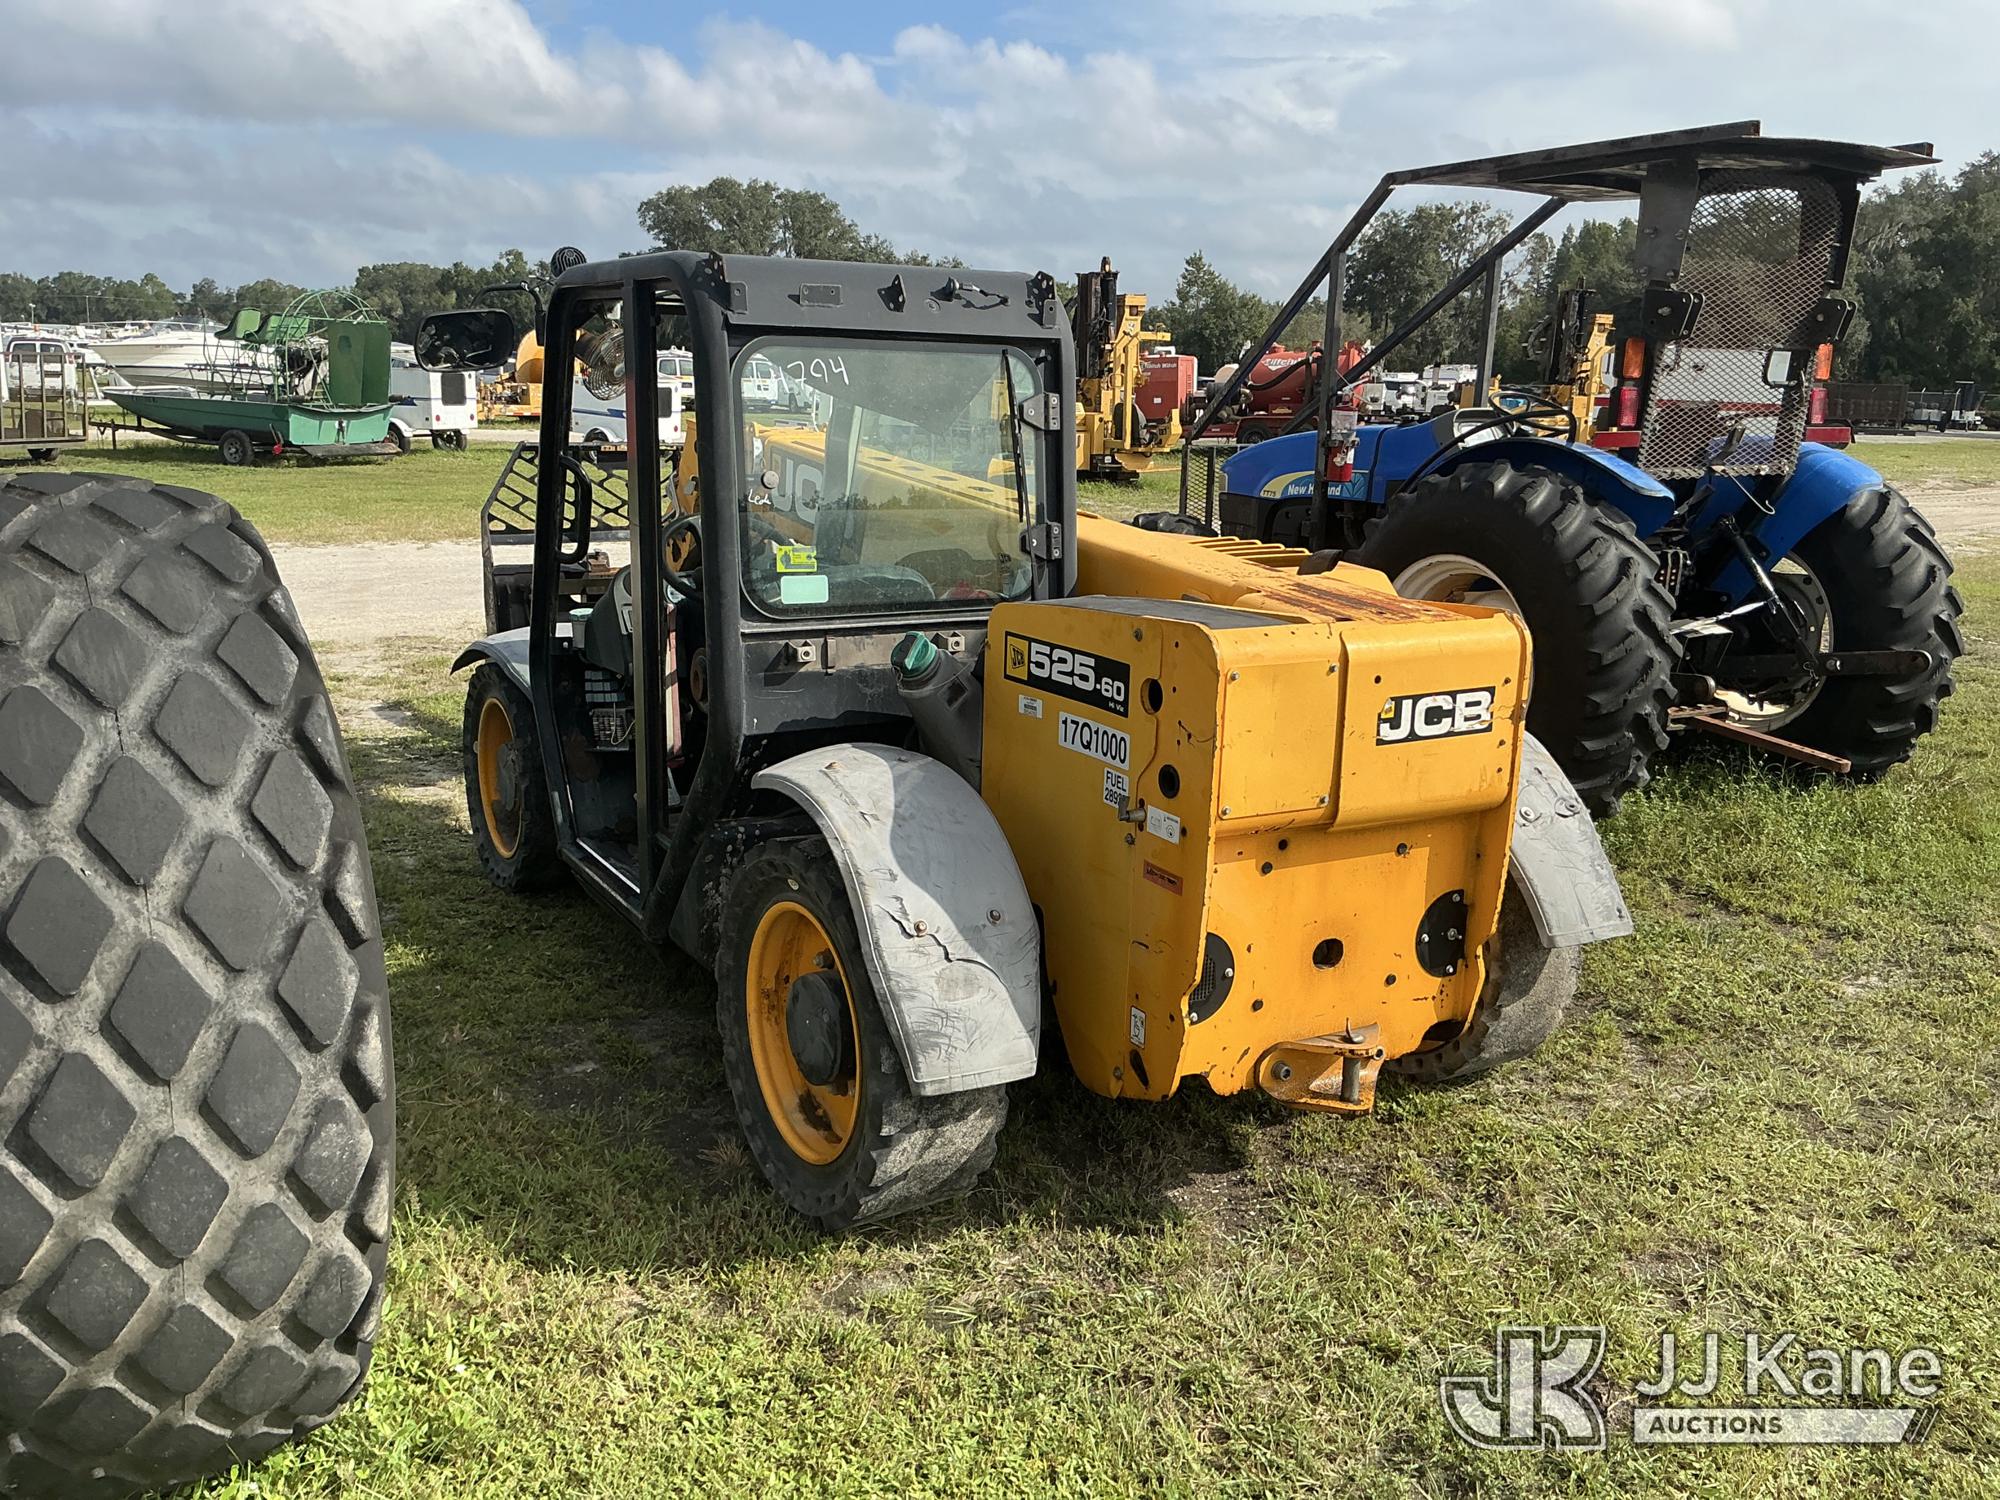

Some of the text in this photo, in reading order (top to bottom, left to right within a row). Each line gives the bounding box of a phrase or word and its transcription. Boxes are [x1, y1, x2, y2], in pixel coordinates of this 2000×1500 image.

[771, 458, 822, 524] JC
[1287, 484, 1307, 495] New
[1380, 691, 1492, 741] JCB
[1061, 717, 1127, 764] 17Q1000
[1104, 787, 1122, 805] 289
[1106, 771, 1126, 792] FUEL
